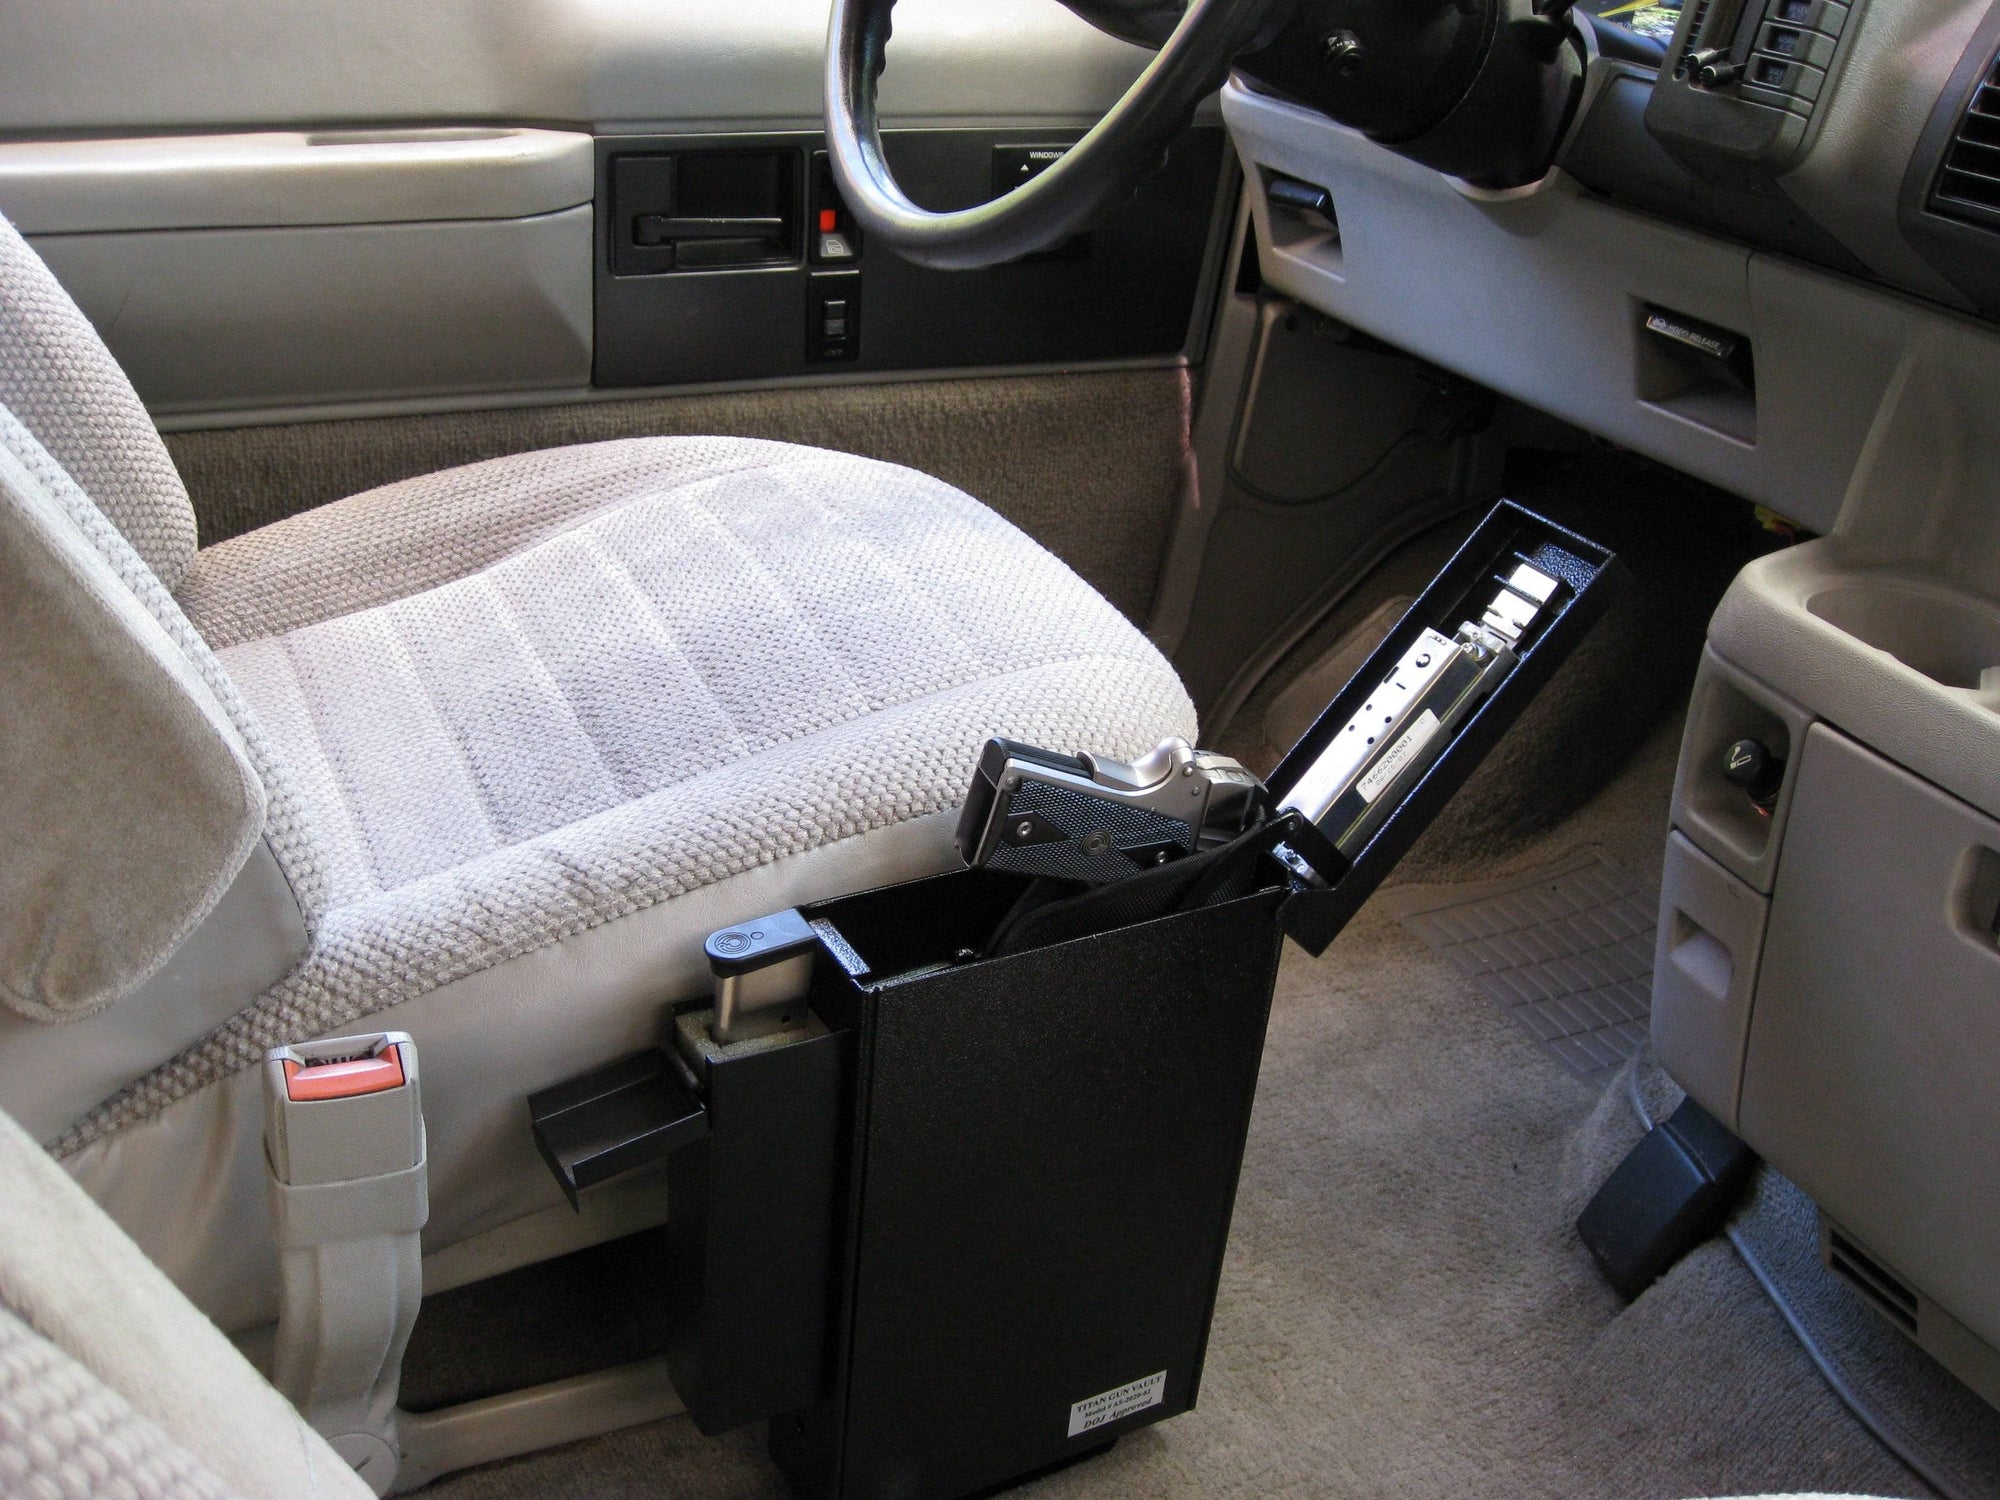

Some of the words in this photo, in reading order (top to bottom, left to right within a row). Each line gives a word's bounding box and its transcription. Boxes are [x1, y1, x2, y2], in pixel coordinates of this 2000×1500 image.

[1690, 333, 1721, 349] RELEASE
[1077, 1396, 1106, 1413] TITAN
[1109, 1388, 1130, 1400] GUN
[1132, 1375, 1162, 1392] VAULT
[1083, 1415, 1106, 1429] DOJ
[1108, 1397, 1152, 1419] Approved
